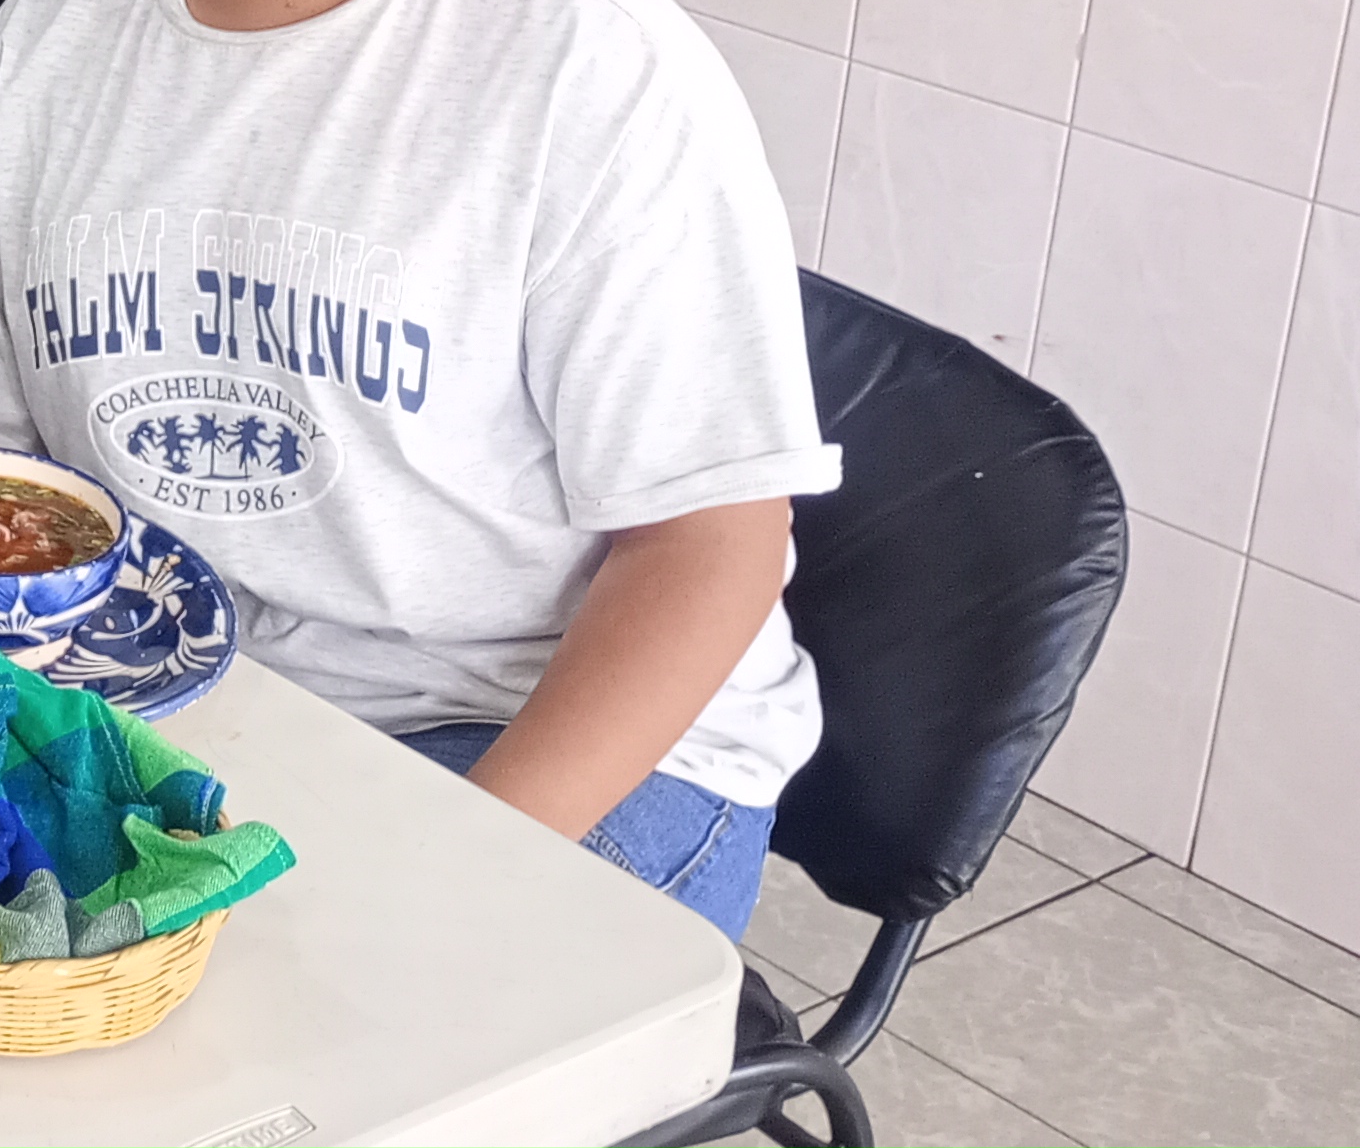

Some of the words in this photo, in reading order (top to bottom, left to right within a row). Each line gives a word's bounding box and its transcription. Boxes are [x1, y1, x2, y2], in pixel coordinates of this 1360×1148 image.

[191, 208, 433, 417] SPRINGS
[95, 377, 242, 425] COACHELLA
[244, 382, 327, 443] VALLEY
[152, 476, 211, 512] EST
[223, 484, 285, 515] 1986
